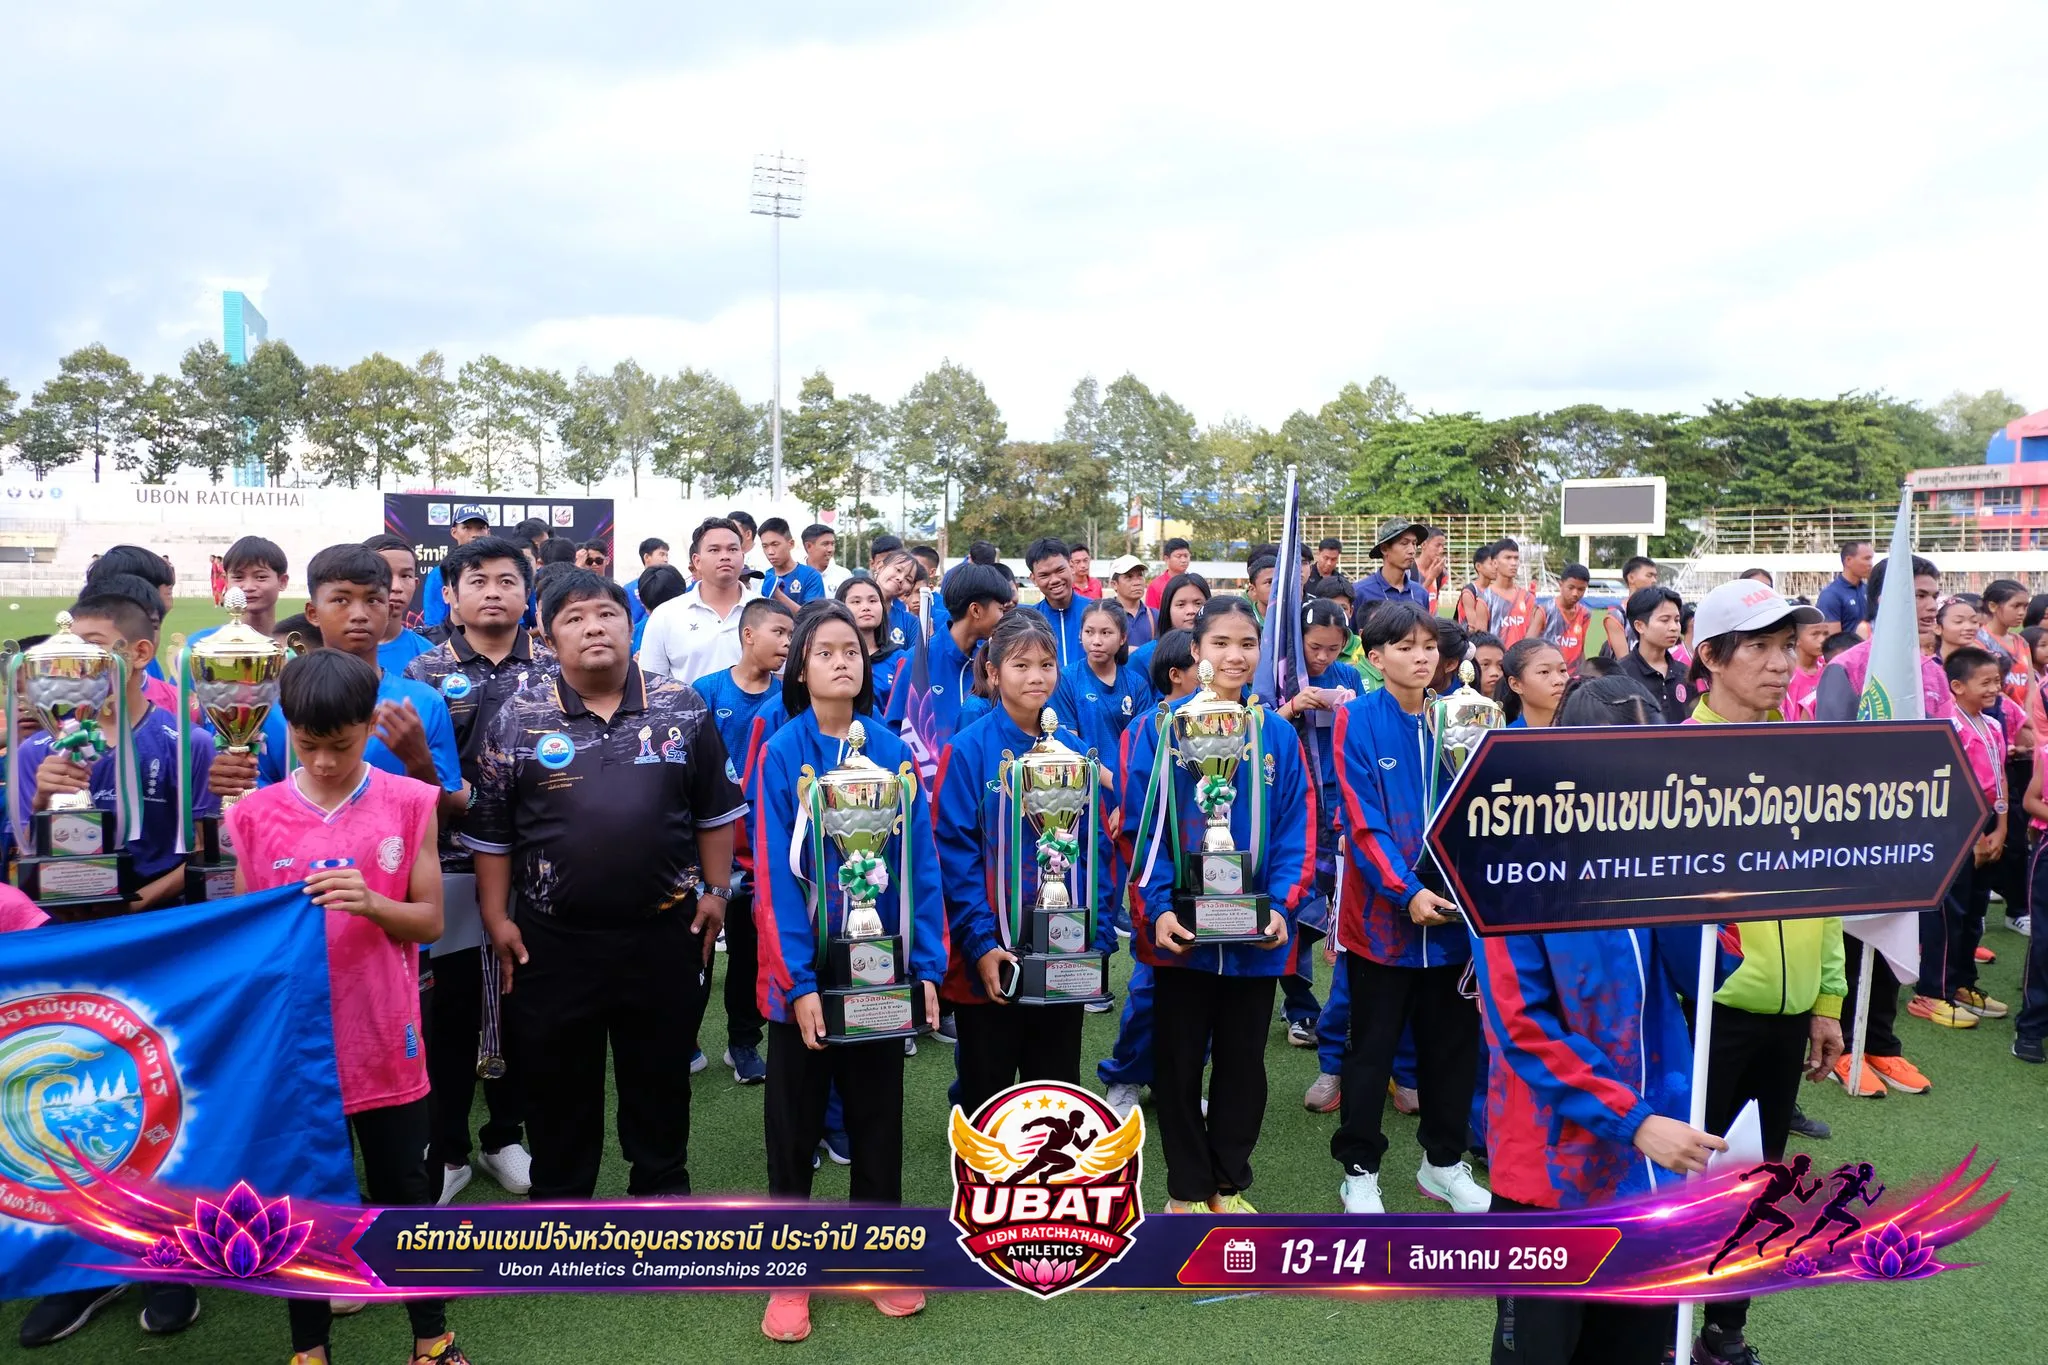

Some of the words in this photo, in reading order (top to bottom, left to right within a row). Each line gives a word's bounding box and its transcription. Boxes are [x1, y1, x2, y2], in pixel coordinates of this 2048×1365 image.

[136, 489, 189, 504] UBON
[197, 490, 304, 507] RATCHATHA
[1500, 615, 1525, 628] KNP
[1467, 764, 1951, 840] กรีฑาชิงแชมป์จังหวัดอุบลราชธานี
[1486, 860, 1567, 885] UBON
[1578, 853, 1726, 881] ATHLETICS
[1738, 843, 1935, 873] CHAMPIONSHIPS
